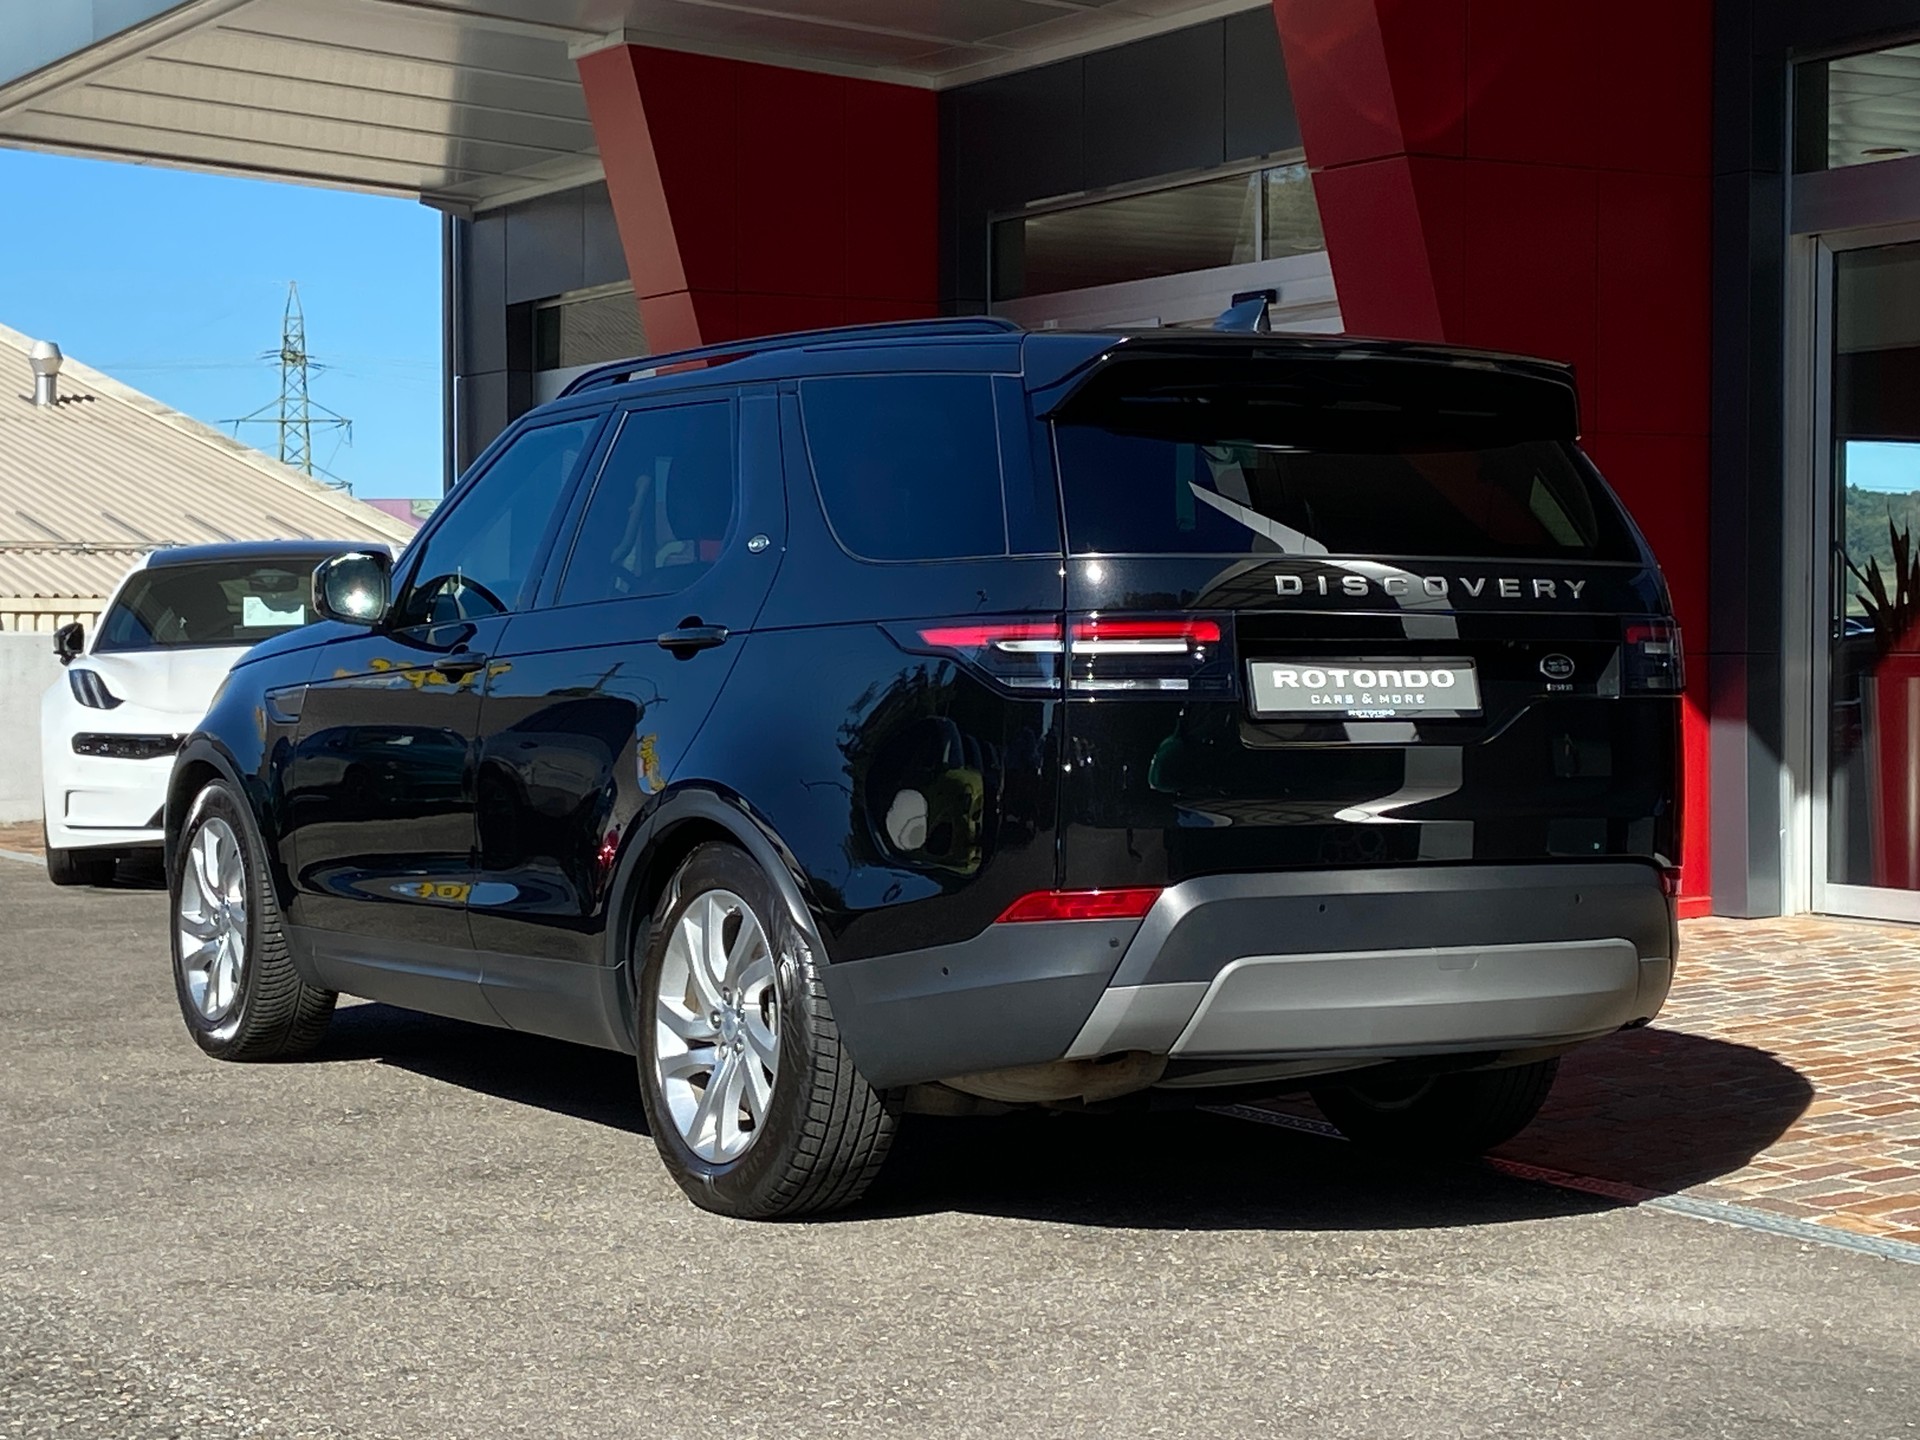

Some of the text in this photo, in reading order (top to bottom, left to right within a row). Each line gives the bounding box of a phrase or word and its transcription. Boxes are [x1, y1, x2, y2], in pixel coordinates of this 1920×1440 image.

[1274, 575, 1586, 599] DISCOVERY
[1272, 669, 1455, 688] ROTONDO
[1311, 692, 1425, 705] CARS & MORE
